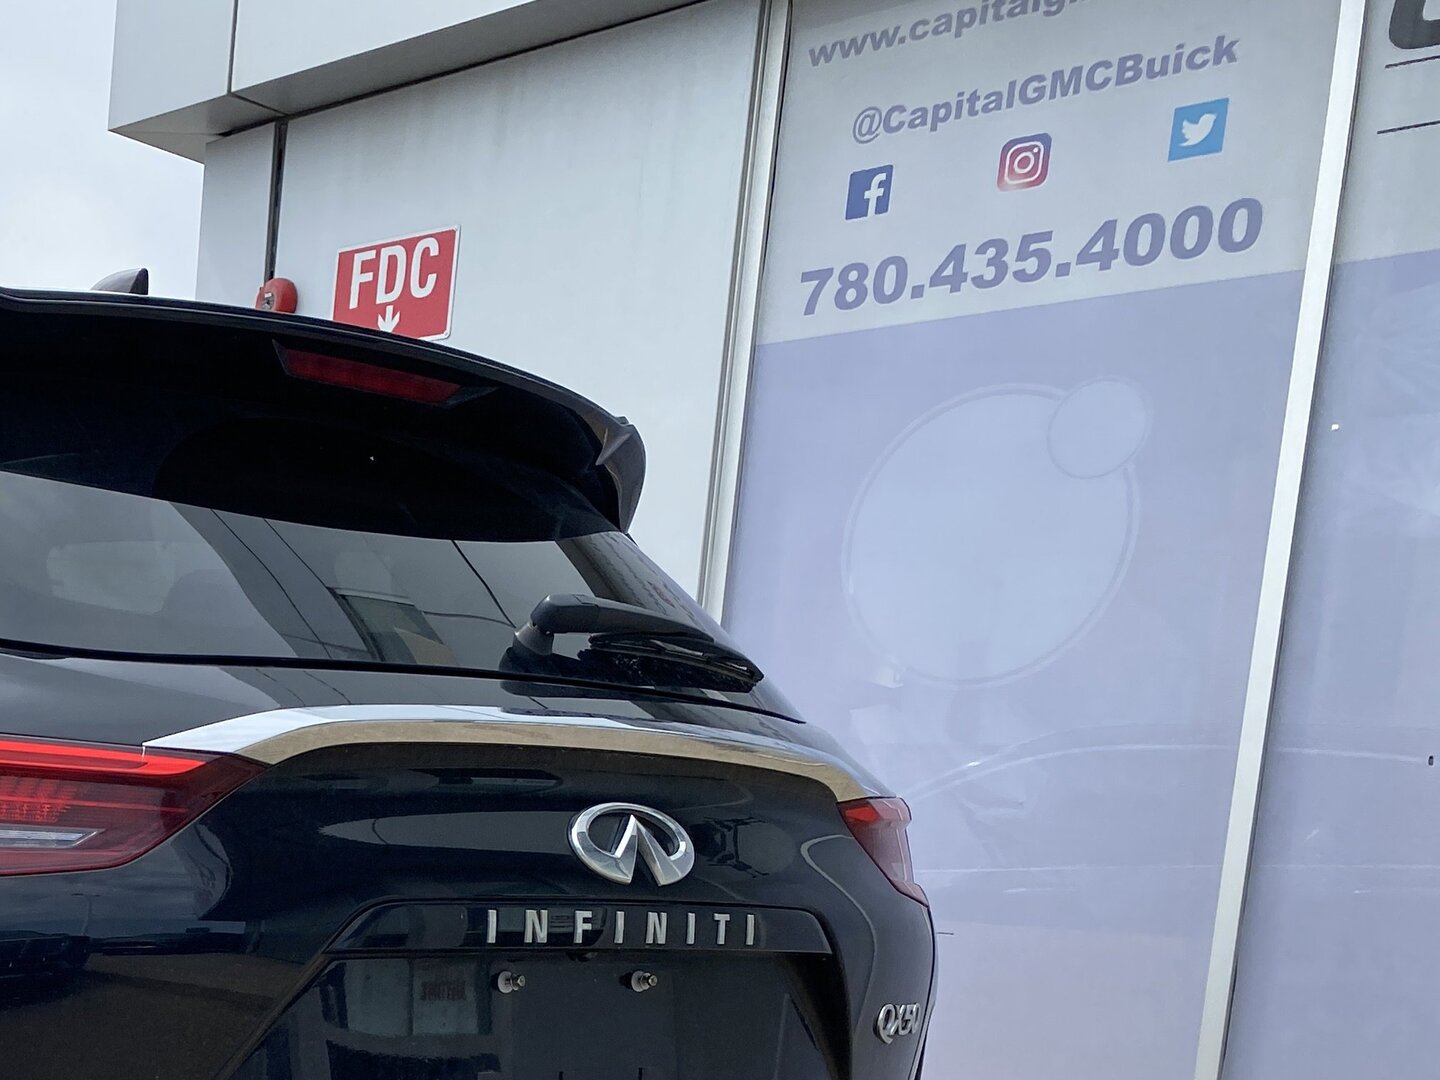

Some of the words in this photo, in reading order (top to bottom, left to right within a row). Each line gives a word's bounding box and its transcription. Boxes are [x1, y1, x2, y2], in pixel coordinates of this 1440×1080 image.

[808, 0, 1086, 67] www.capitag
[852, 35, 1240, 144] @CapitalGMCBuick
[348, 236, 440, 310] FDC
[800, 197, 1263, 317] 780.435.4000
[486, 909, 757, 945] INFINITI
